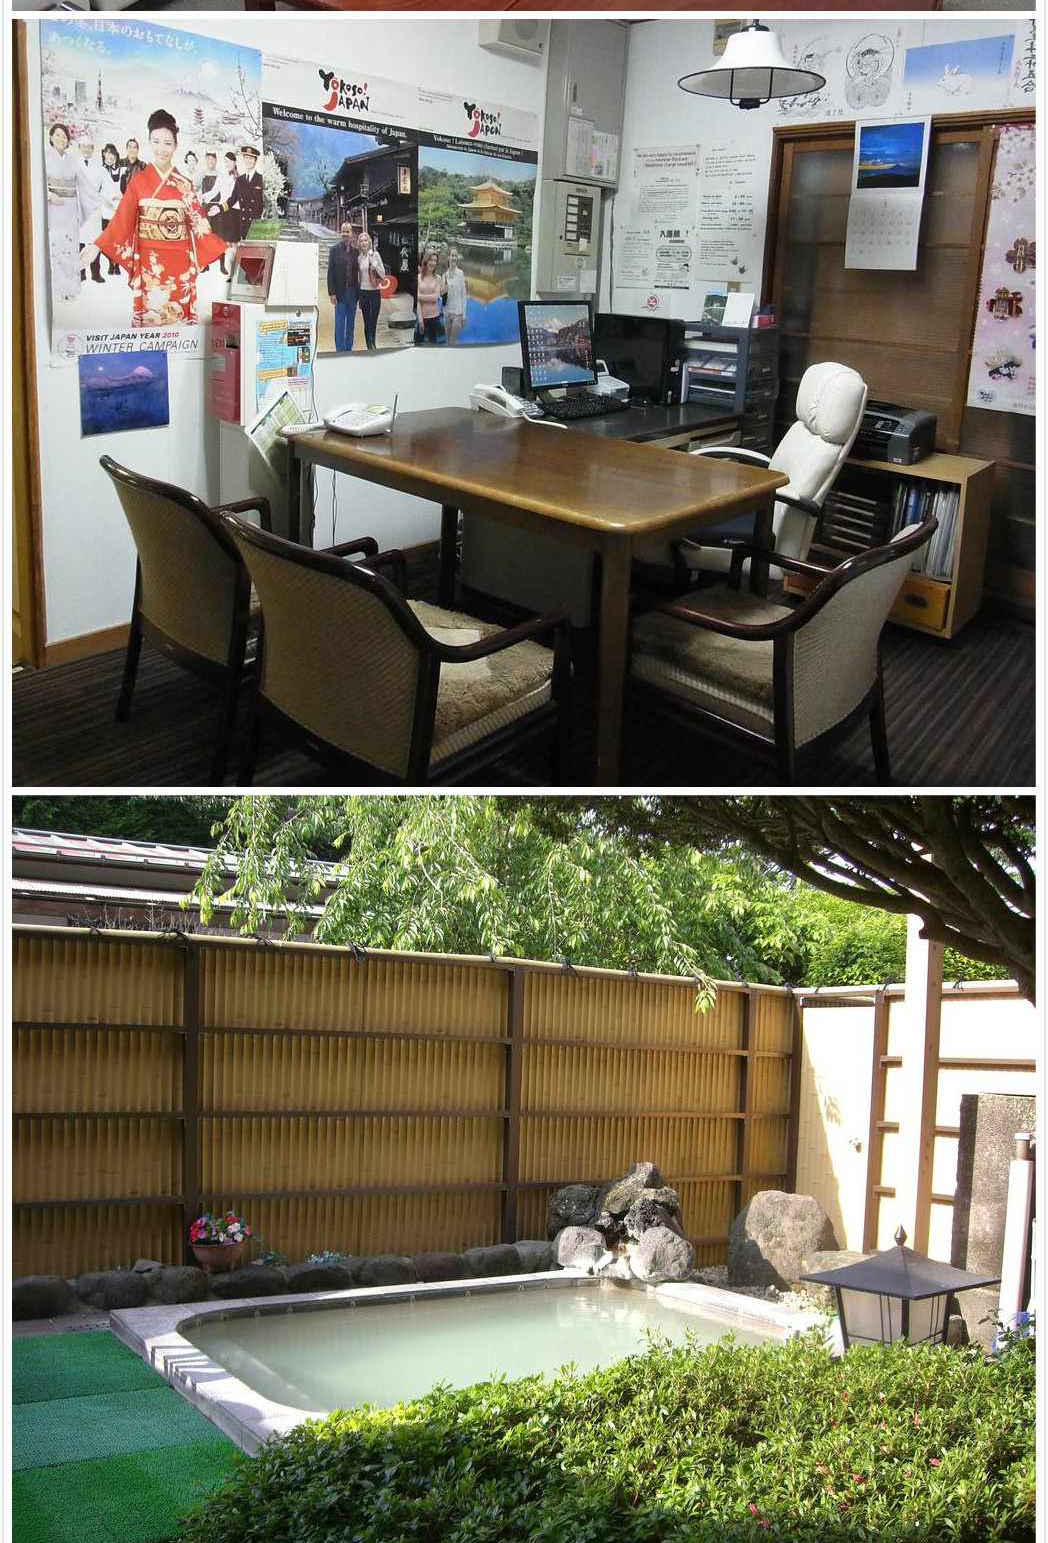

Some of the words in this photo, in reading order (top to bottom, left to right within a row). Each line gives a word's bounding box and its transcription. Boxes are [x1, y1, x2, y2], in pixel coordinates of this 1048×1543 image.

[322, 92, 370, 112] JAPAN
[272, 107, 304, 120] Welcome
[305, 114, 312, 122] to
[314, 115, 325, 124] the
[327, 118, 346, 127] warm
[349, 120, 379, 134] hospitality
[381, 127, 388, 135] of
[389, 128, 408, 139] Japan.
[86, 334, 108, 342] VISIT
[110, 333, 137, 341] JAPAN
[86, 342, 134, 354] WINTER
[140, 339, 199, 352] CAMPAIGN
